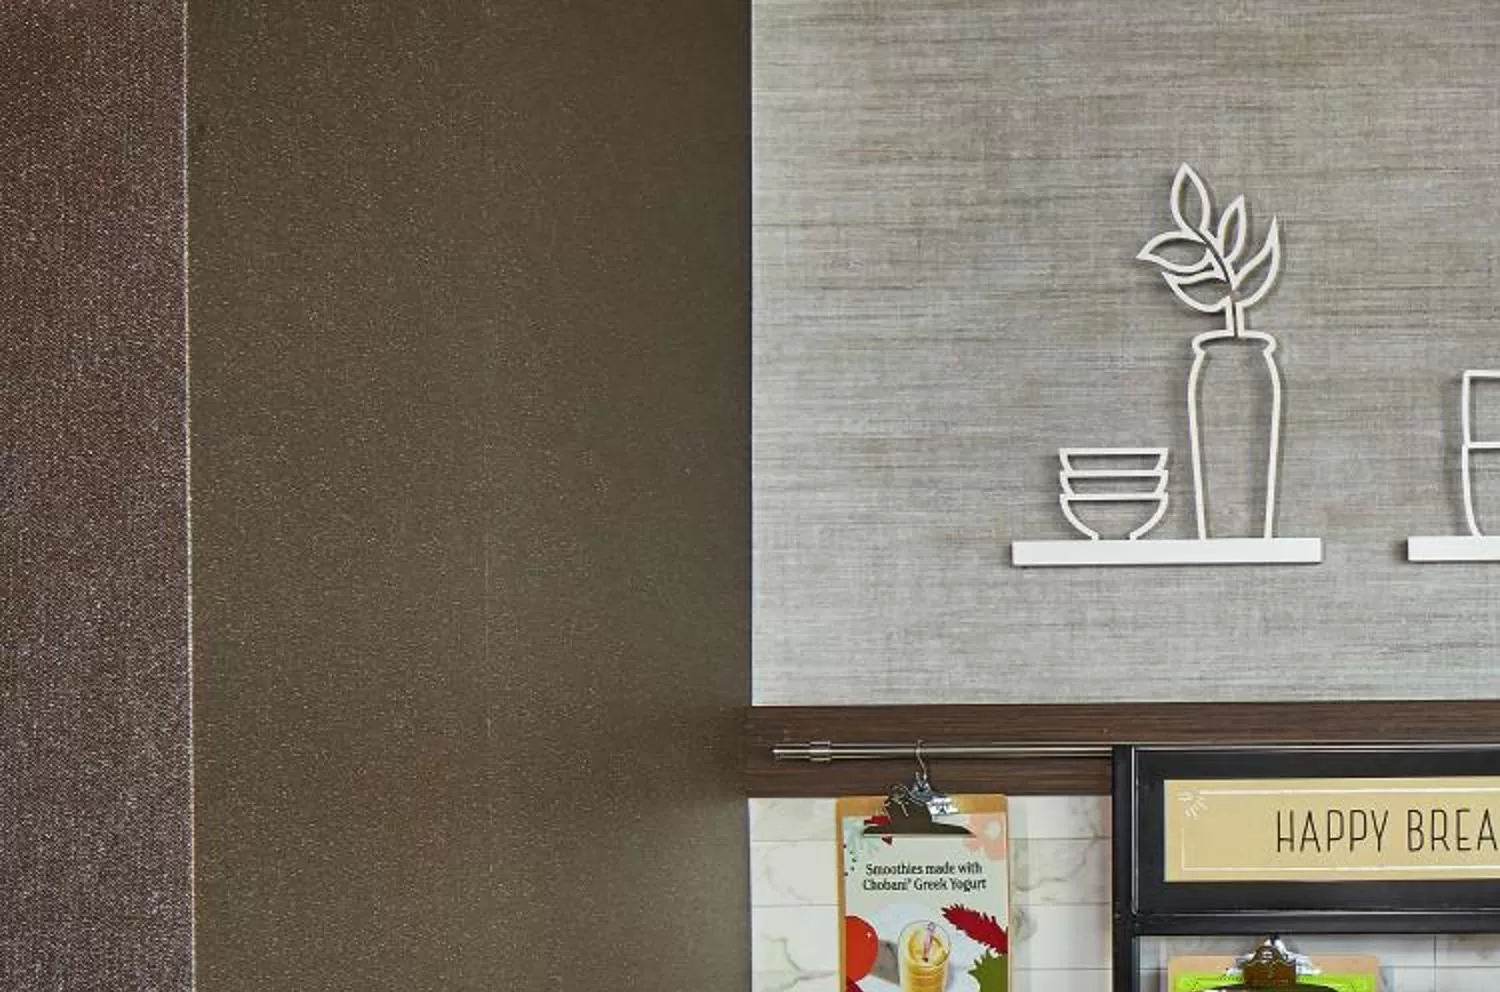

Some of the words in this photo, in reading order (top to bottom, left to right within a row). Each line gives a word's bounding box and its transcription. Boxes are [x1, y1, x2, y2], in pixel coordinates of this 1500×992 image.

[1276, 808, 1389, 853] HAPPY
[865, 862, 924, 876] Smoothies
[925, 861, 956, 875] made
[957, 861, 984, 874] with
[913, 877, 948, 891] Greek
[949, 877, 987, 893] Yogurt
